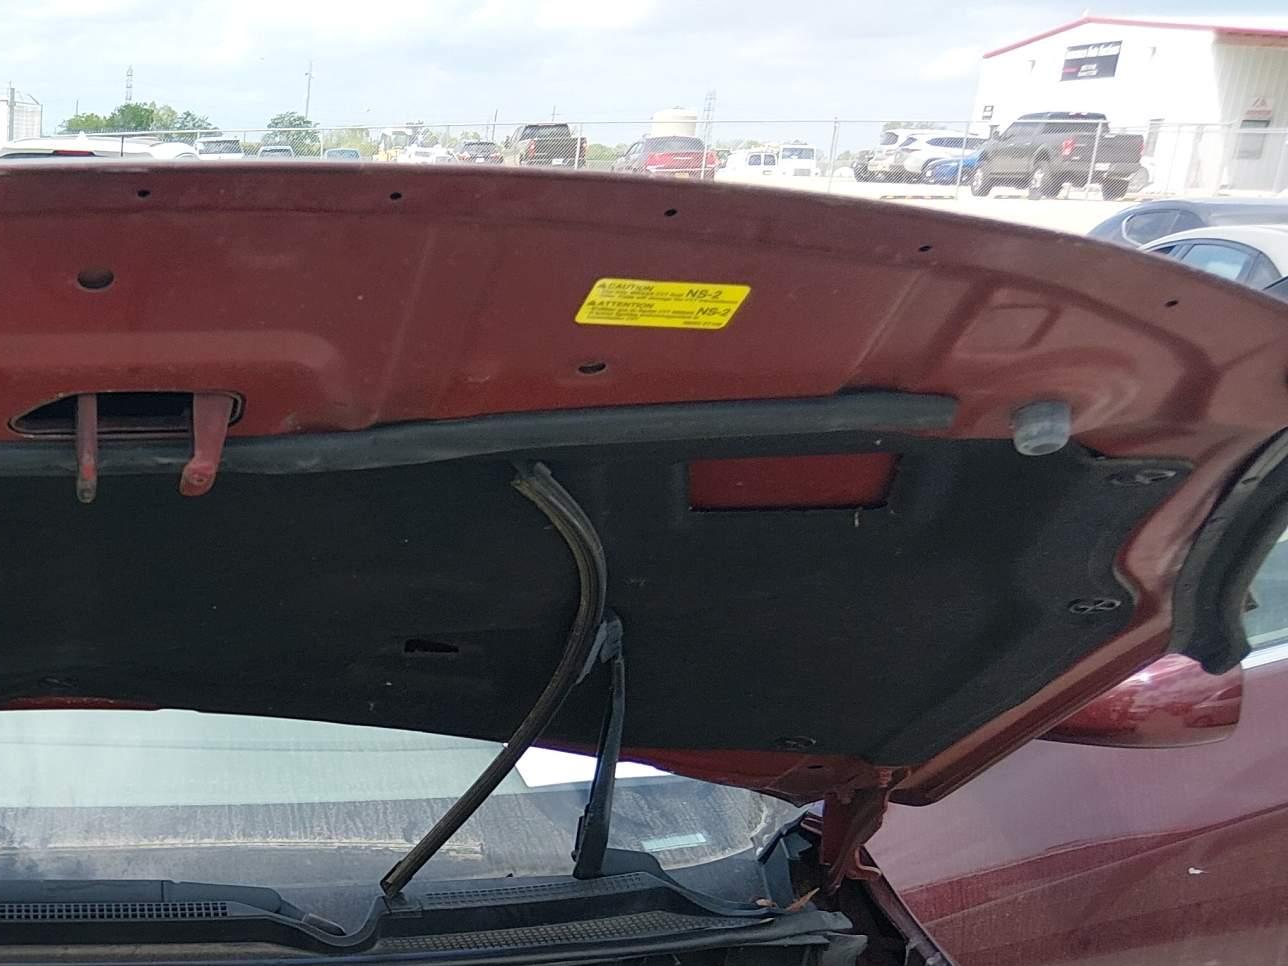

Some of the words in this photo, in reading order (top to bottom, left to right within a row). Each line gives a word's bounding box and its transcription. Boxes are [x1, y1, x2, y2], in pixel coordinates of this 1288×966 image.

[607, 282, 655, 292] CAUTION
[686, 288, 722, 300] NS-2
[597, 300, 655, 309] ATTENTION
[695, 306, 731, 318] NS-2
